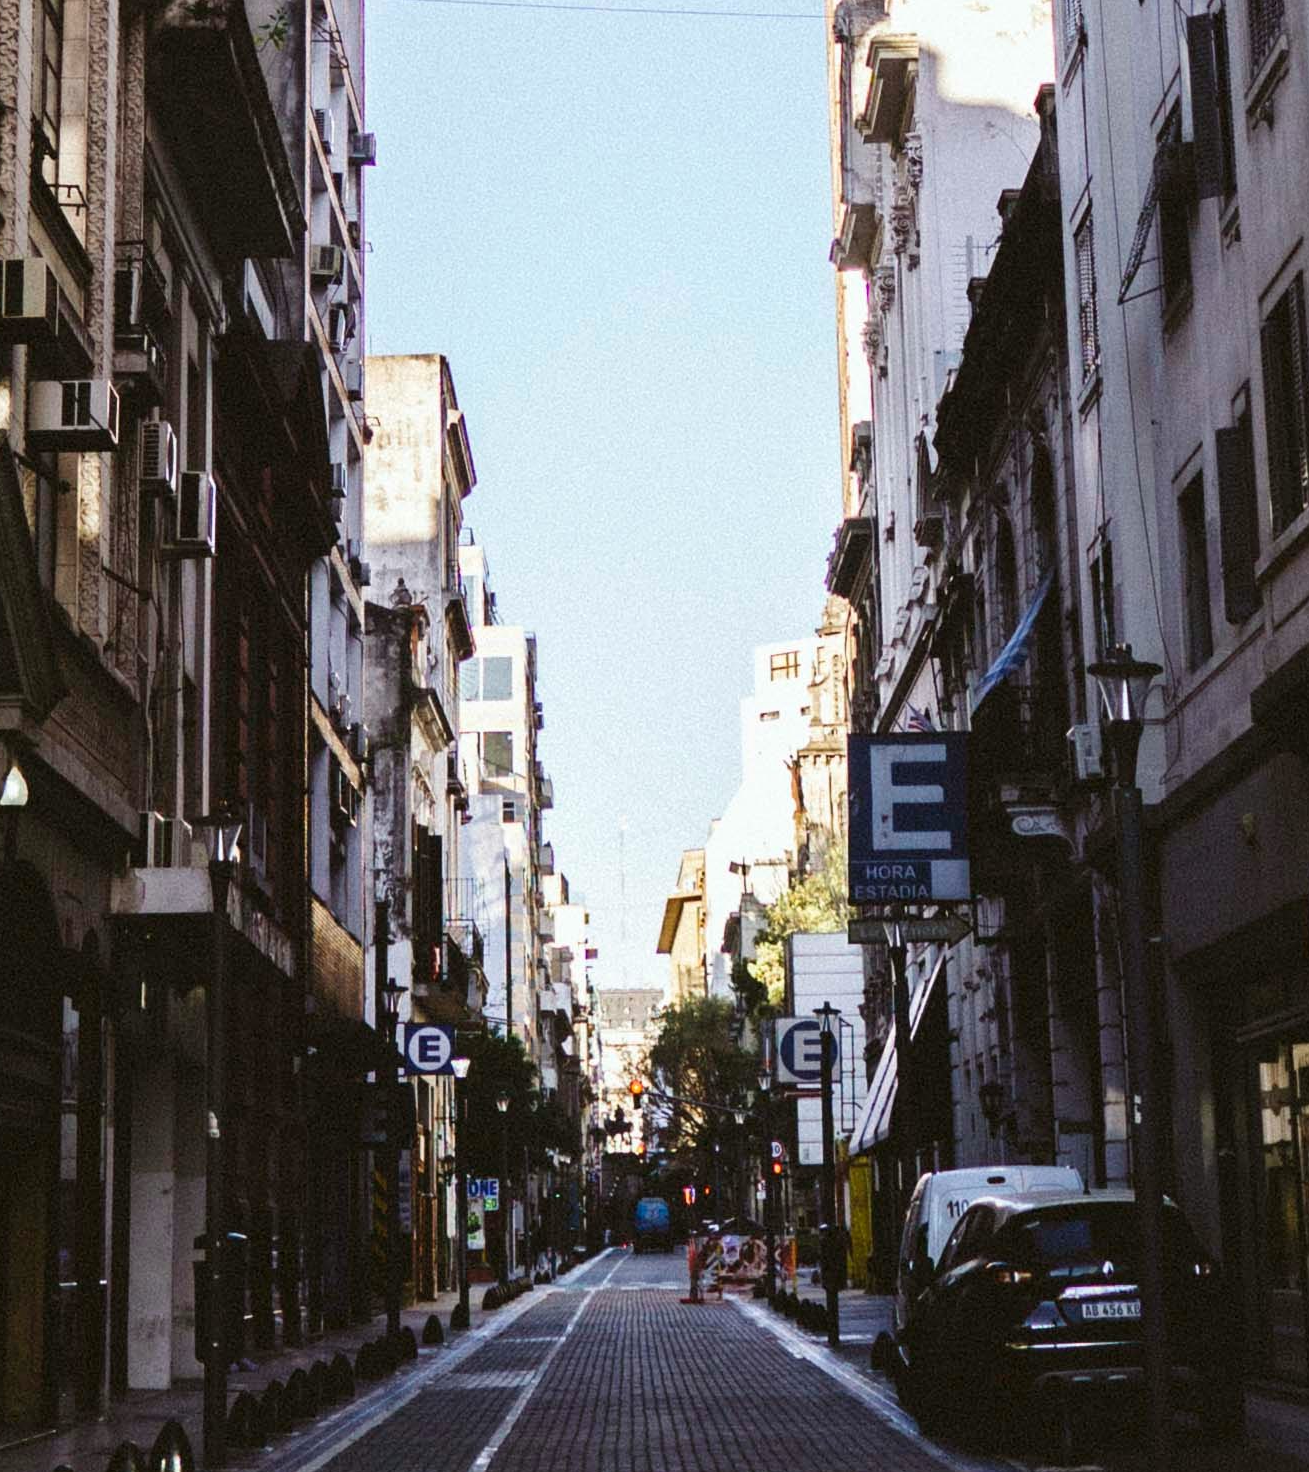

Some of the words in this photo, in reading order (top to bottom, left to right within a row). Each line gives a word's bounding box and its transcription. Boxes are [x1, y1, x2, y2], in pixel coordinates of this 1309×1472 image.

[870, 744, 951, 850] E
[866, 865, 916, 879] HORA
[854, 884, 930, 899] ESTADIA
[419, 1035, 441, 1063] E
[793, 1030, 822, 1071] E
[1085, 1304, 1099, 1317] AB
[1102, 1304, 1124, 1316] 456
